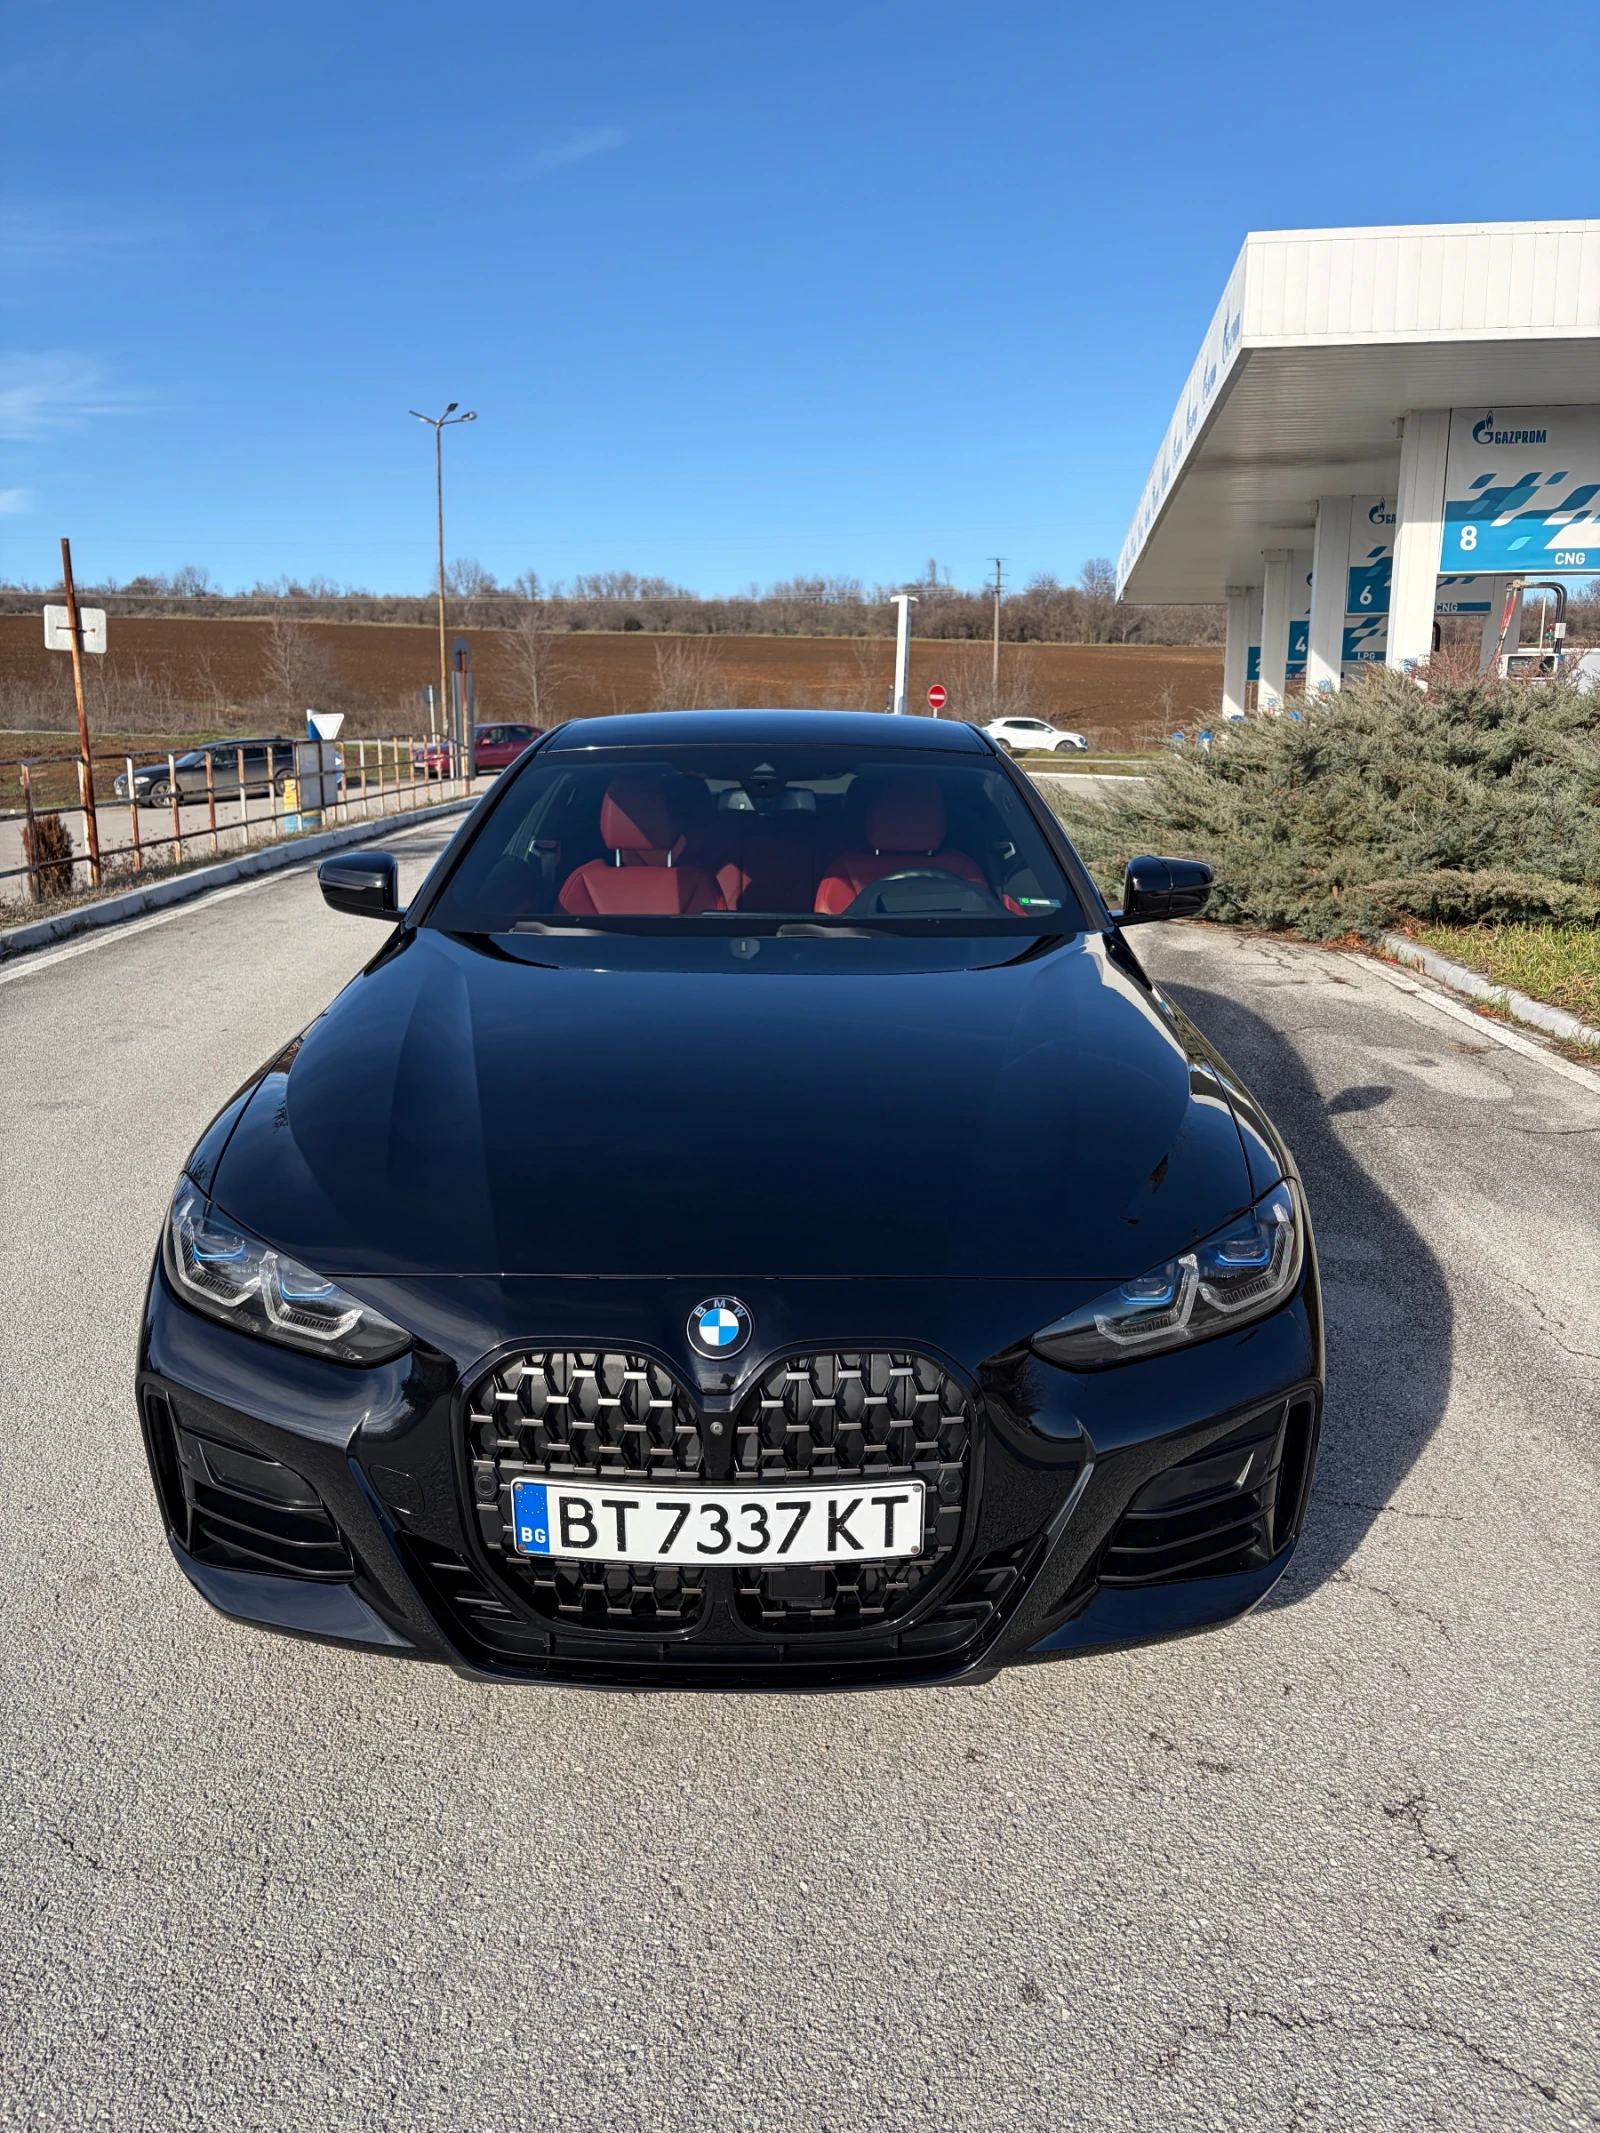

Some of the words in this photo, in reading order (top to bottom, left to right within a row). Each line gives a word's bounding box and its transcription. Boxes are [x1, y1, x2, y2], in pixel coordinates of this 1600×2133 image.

[1494, 430, 1547, 445] GAZPROM
[1459, 525, 1478, 551] 8
[1554, 552, 1586, 565] CNG
[1359, 585, 1373, 605] 6
[1435, 603, 1458, 613] CNG
[1295, 636, 1307, 653] 4
[1357, 652, 1376, 661] LPG
[694, 1299, 747, 1318] BMW
[558, 1496, 640, 1553] BT
[656, 1501, 812, 1555] 7337
[827, 1494, 910, 1552] KT
[521, 1527, 546, 1544] BG
